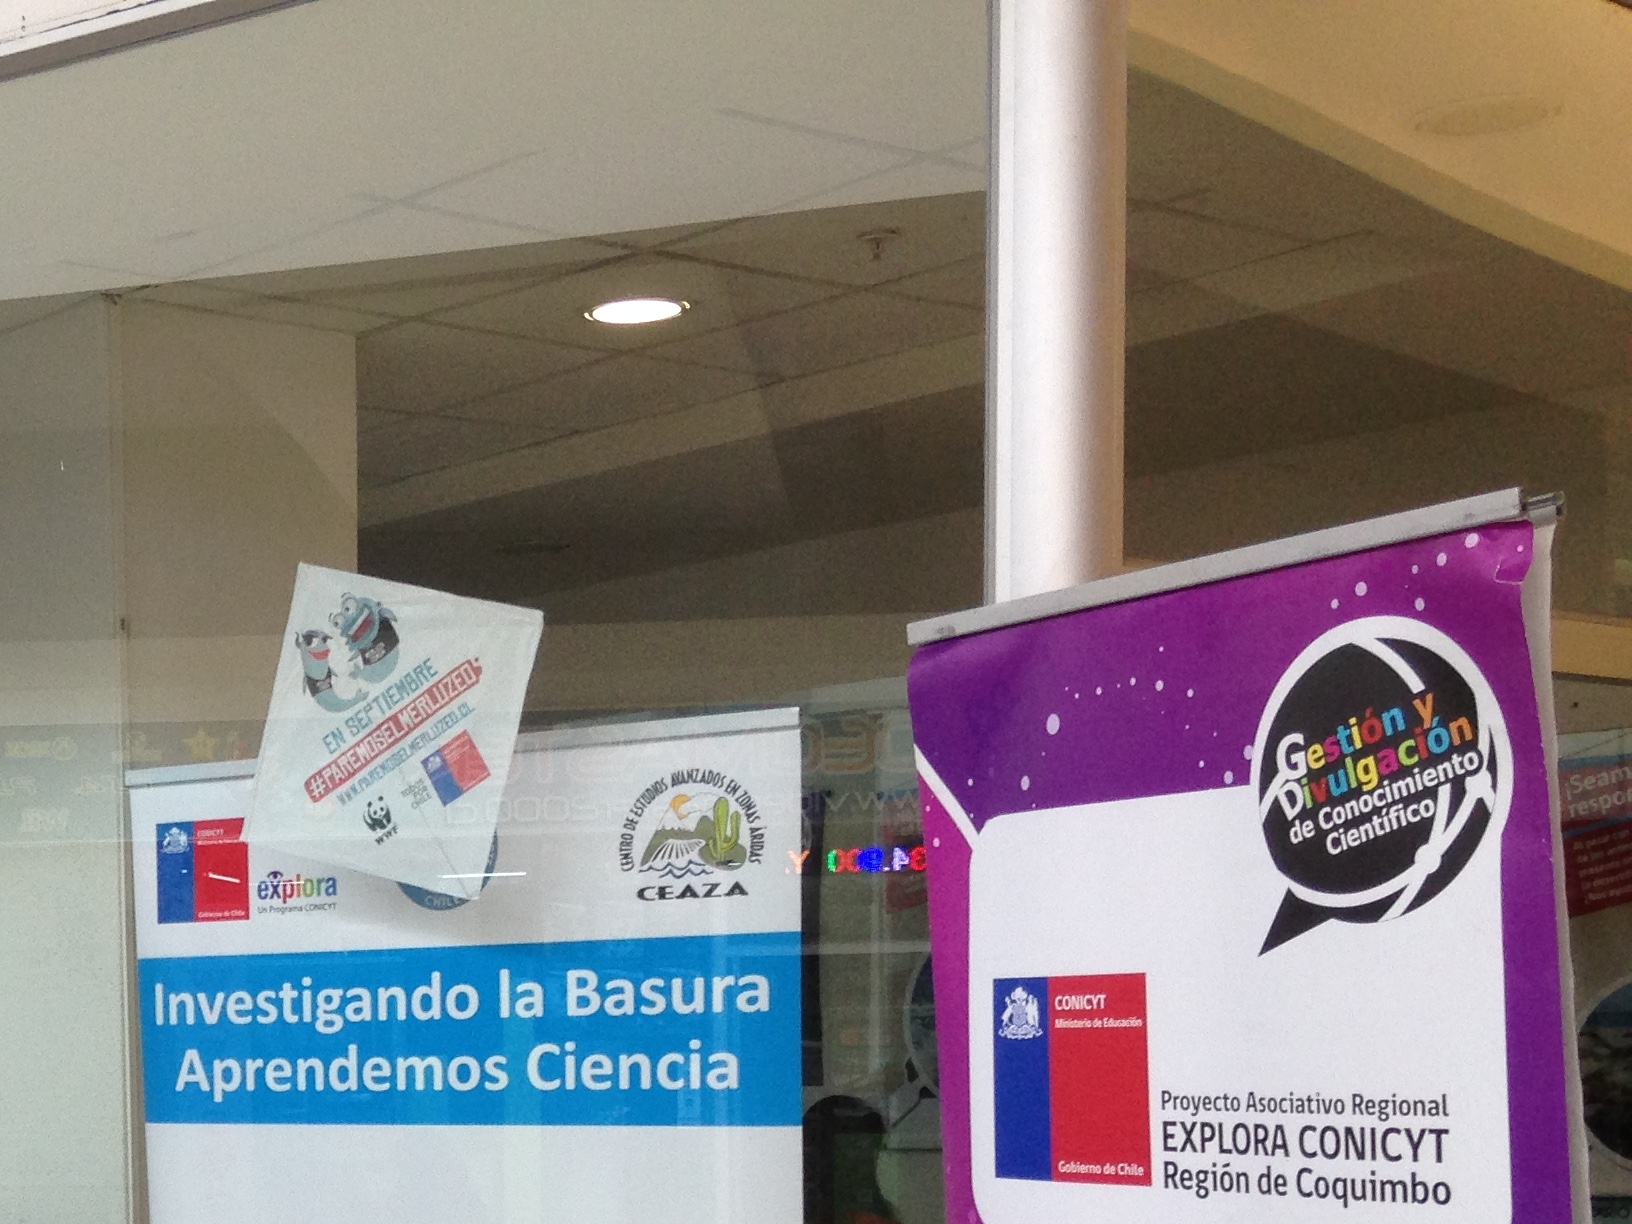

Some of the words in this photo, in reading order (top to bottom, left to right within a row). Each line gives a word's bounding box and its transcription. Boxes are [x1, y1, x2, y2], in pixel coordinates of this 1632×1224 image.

[322, 727, 345, 754] EN
[345, 657, 439, 738] SEPTIEMBRE
[1276, 706, 1407, 782] Gestión
[1412, 692, 1435, 730] y
[670, 768, 727, 789] AVANZADOS
[1277, 716, 1474, 821] Divulgación
[630, 777, 668, 818] ESTUDIOS
[725, 779, 741, 797] EN
[1288, 820, 1316, 845] de
[1318, 750, 1480, 830] Conocimiento
[624, 815, 639, 831] DE
[734, 789, 761, 825] ZONAS
[374, 824, 399, 846] WWF
[748, 826, 767, 865] ÁRIDAS
[1325, 799, 1436, 855] Científico
[619, 834, 635, 872] CENTRO
[257, 873, 338, 904] explora
[636, 881, 749, 901] CEAZA
[257, 905, 268, 914] Un
[269, 904, 304, 915] Programa
[153, 971, 480, 1035] Investigando
[498, 968, 545, 1019] la
[565, 968, 772, 1018] Basura
[1054, 994, 1107, 1011] CONICYT
[1054, 1017, 1092, 1029] Ministerio
[1092, 1017, 1103, 1028] de
[174, 1044, 509, 1102] Aprendemos
[526, 1039, 740, 1092] Ciencia
[1160, 1090, 1241, 1116] Proyecto
[1245, 1090, 1346, 1116] Asociativo
[1351, 1091, 1450, 1121] Regional
[1161, 1121, 1290, 1158] EXPLORA
[1298, 1124, 1450, 1165] CONICYT
[1057, 1160, 1102, 1176] Gobierno
[1103, 1161, 1116, 1175] de
[1117, 1161, 1145, 1177] Chile
[1162, 1160, 1251, 1199] Región
[1256, 1165, 1288, 1197] de
[1296, 1166, 1453, 1209] Coquimbo
